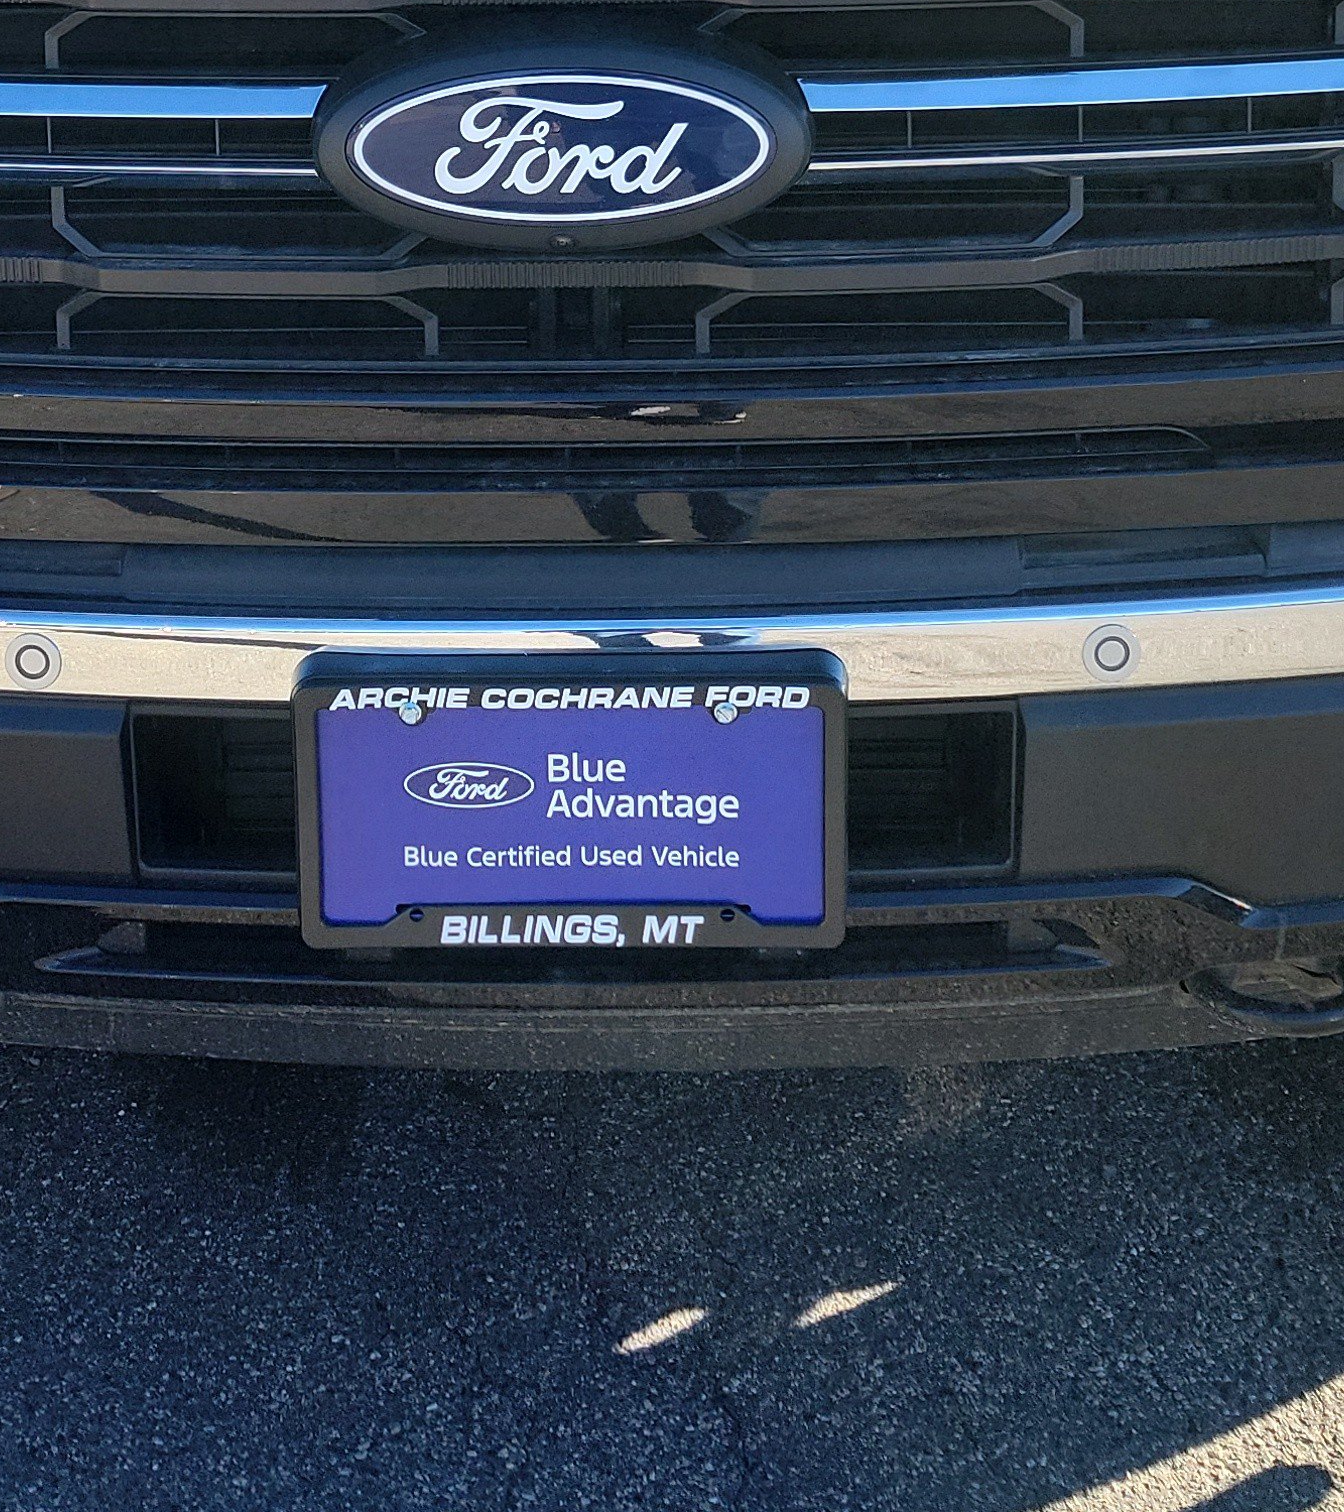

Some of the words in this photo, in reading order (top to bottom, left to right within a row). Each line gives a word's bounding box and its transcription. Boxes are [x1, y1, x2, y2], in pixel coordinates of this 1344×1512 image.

[434, 96, 690, 196] Ford
[329, 686, 469, 711] ARCHIE
[481, 686, 695, 710] COCHRANE
[704, 685, 811, 710] FORD
[547, 752, 627, 783] Blue
[428, 768, 508, 802] Ford
[546, 787, 740, 825] Advantage
[404, 845, 458, 867] Blue
[466, 844, 571, 867] Certified
[580, 844, 643, 867] Used
[651, 844, 740, 867] Vehicle
[440, 914, 626, 947] BILLINGS,
[641, 915, 705, 944] MT
